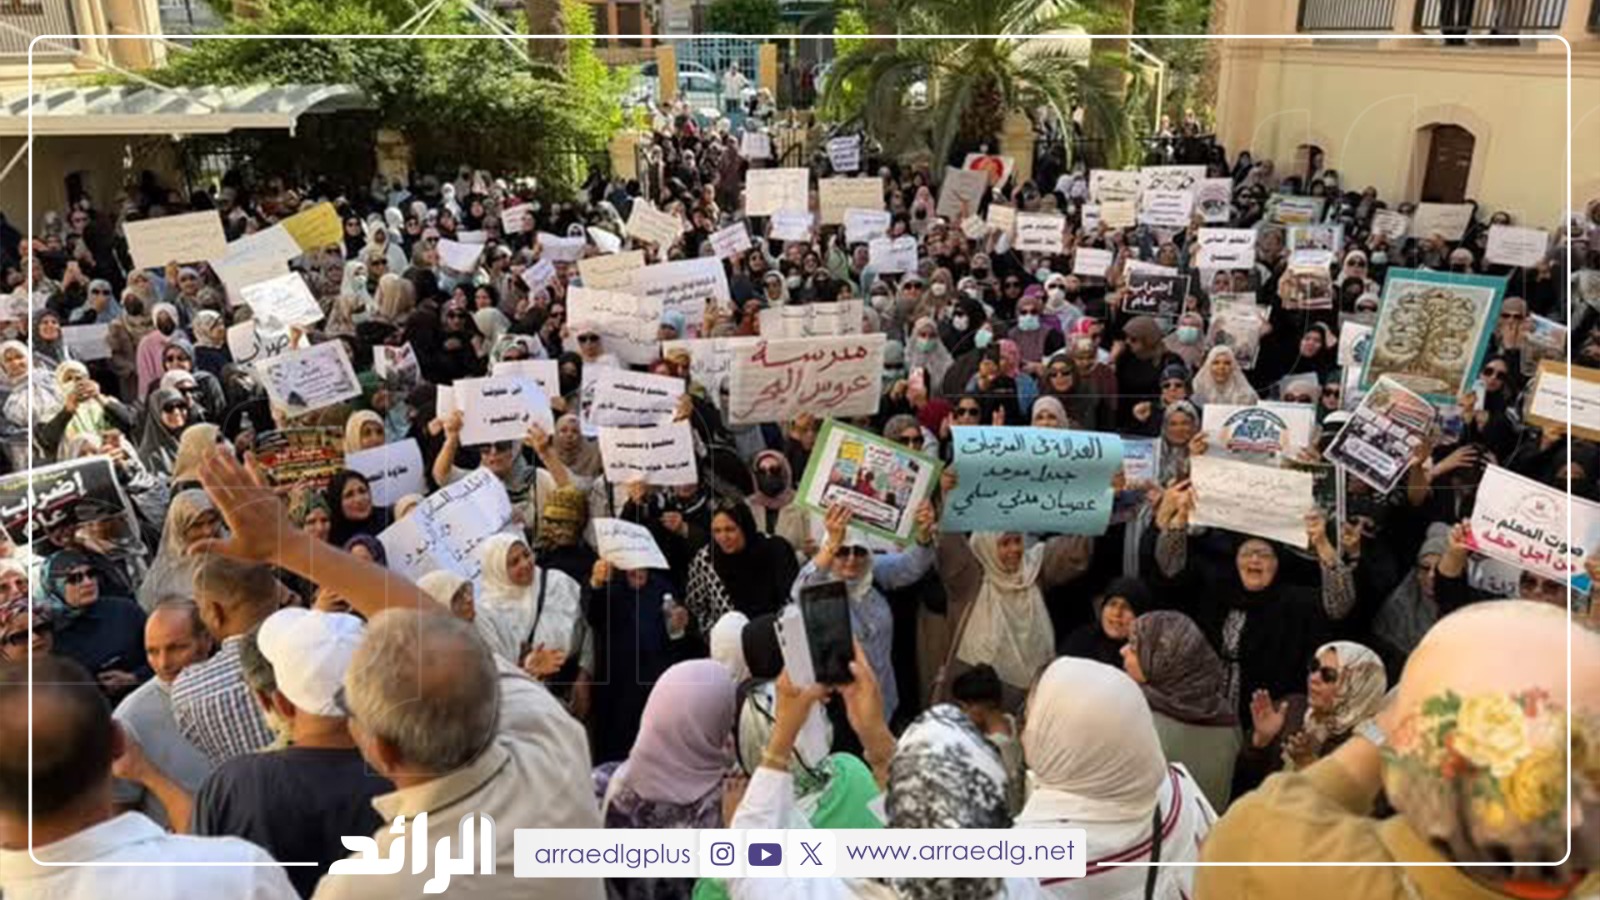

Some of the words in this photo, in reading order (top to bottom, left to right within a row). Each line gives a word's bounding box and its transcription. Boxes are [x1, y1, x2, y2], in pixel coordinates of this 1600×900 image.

[1131, 295, 1157, 309] عام
[751, 340, 868, 372] مدرسة
[732, 366, 804, 419] البحر
[798, 374, 872, 409] عروس
[961, 430, 1026, 457] المرتبات
[1053, 436, 1103, 461] العدالة
[983, 464, 1030, 481] موحد
[1030, 464, 1077, 483] جدول
[997, 488, 1039, 514] مدني
[1040, 490, 1097, 516] عصيان
[1496, 518, 1543, 541] المعلم
[1544, 535, 1584, 558] صوت
[1553, 558, 1577, 572] من
